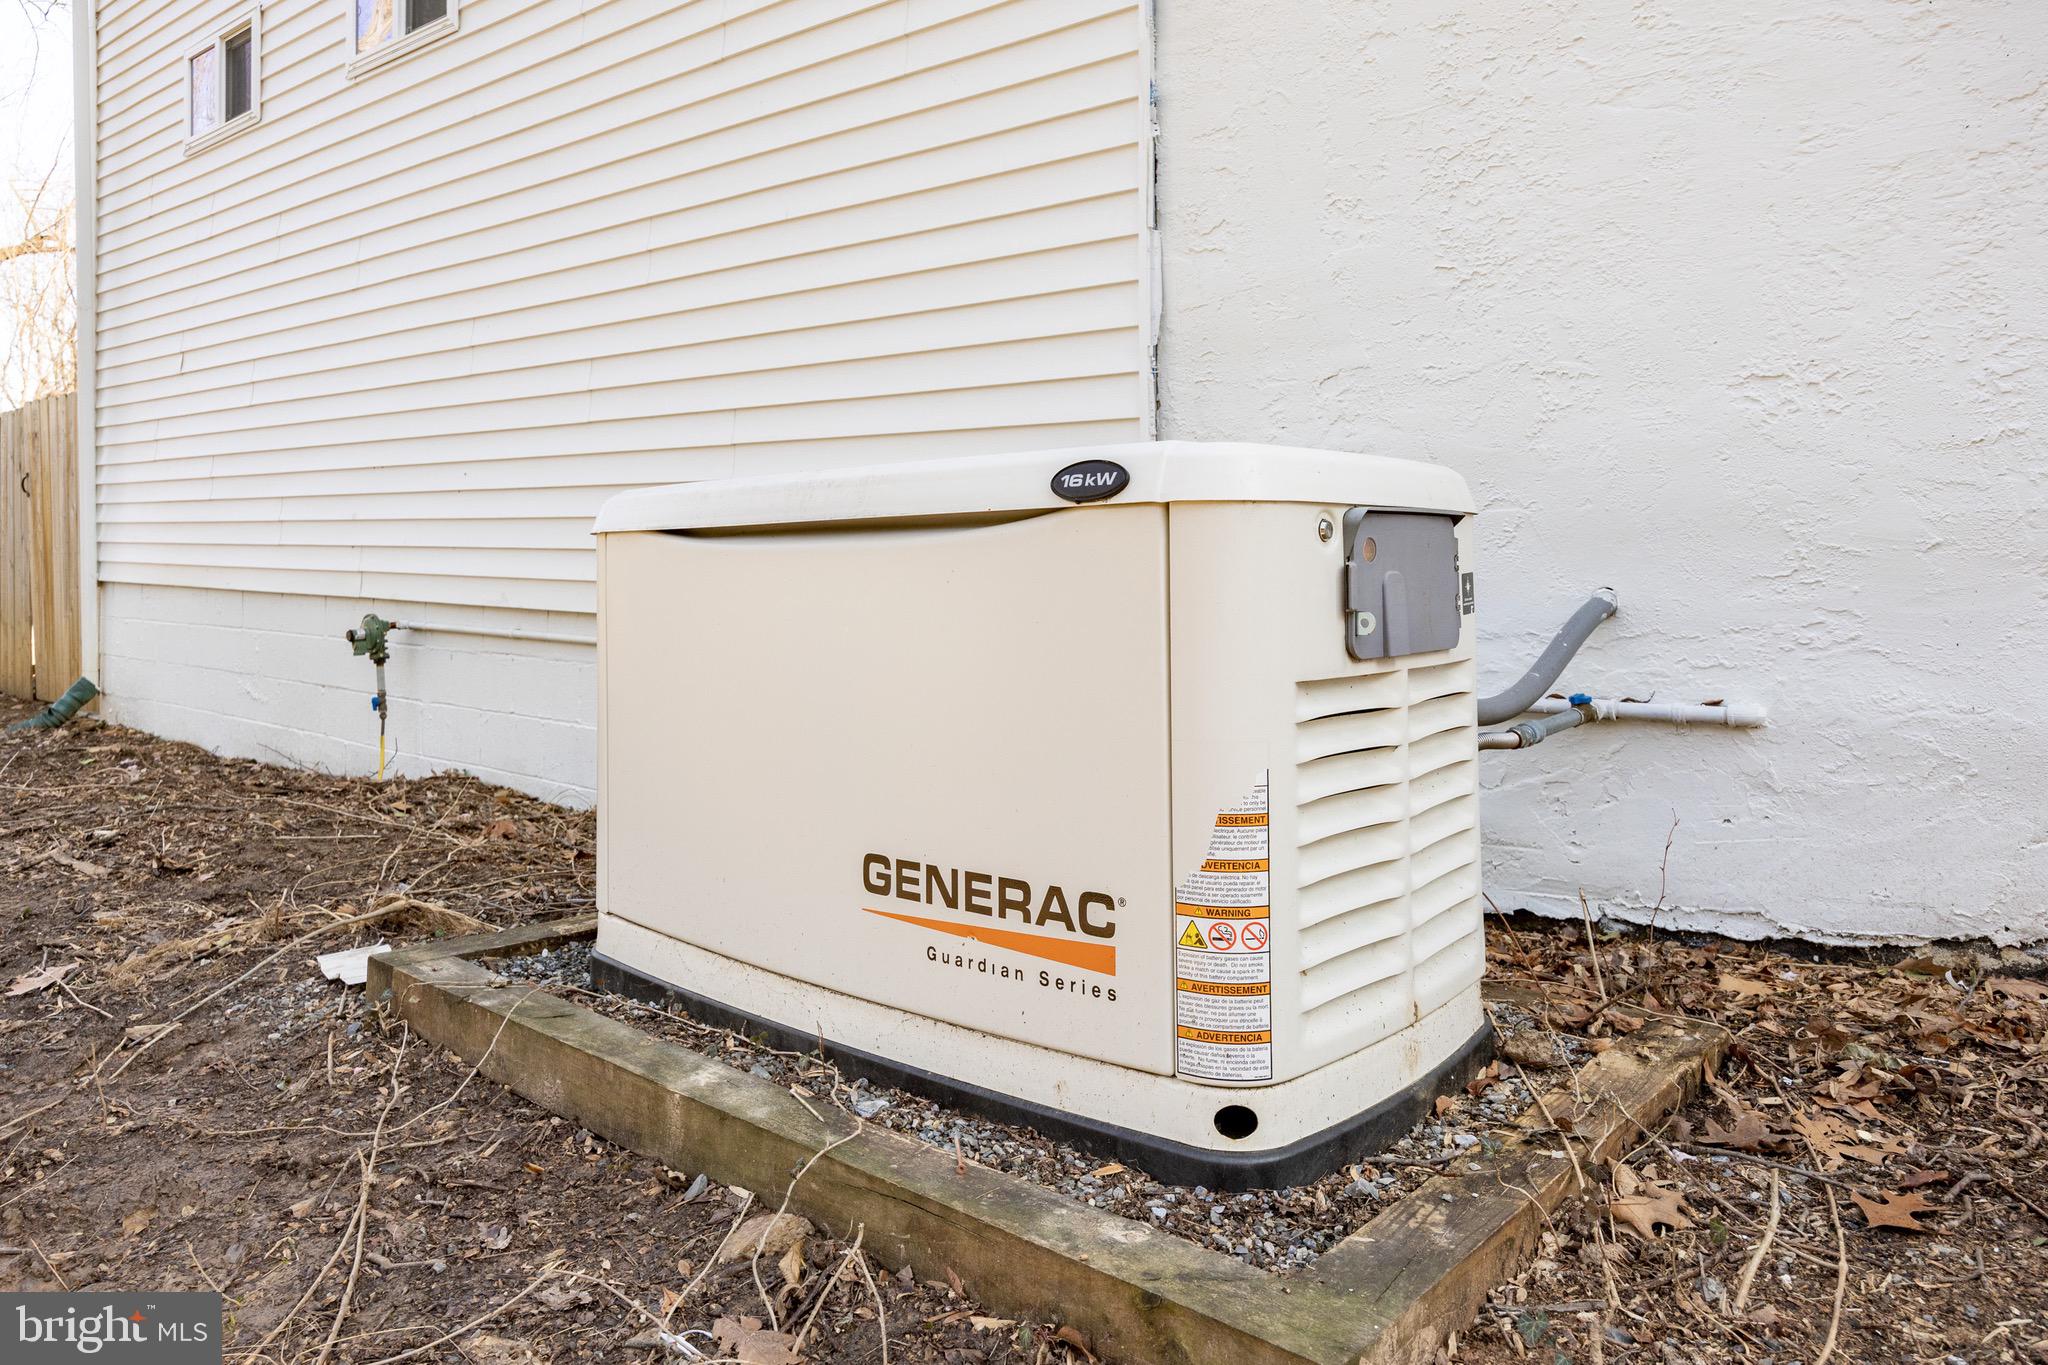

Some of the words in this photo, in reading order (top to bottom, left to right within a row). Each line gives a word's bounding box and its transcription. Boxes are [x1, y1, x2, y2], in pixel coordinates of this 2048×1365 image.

[861, 852, 1117, 939] GENERAC
[1206, 908, 1251, 918] WARNING
[926, 945, 1025, 982] Guardian
[1038, 970, 1118, 1003] Series
[1191, 982, 1268, 995] AVERTISSEMENT
[1196, 1031, 1262, 1042] ADVERTENCIA
